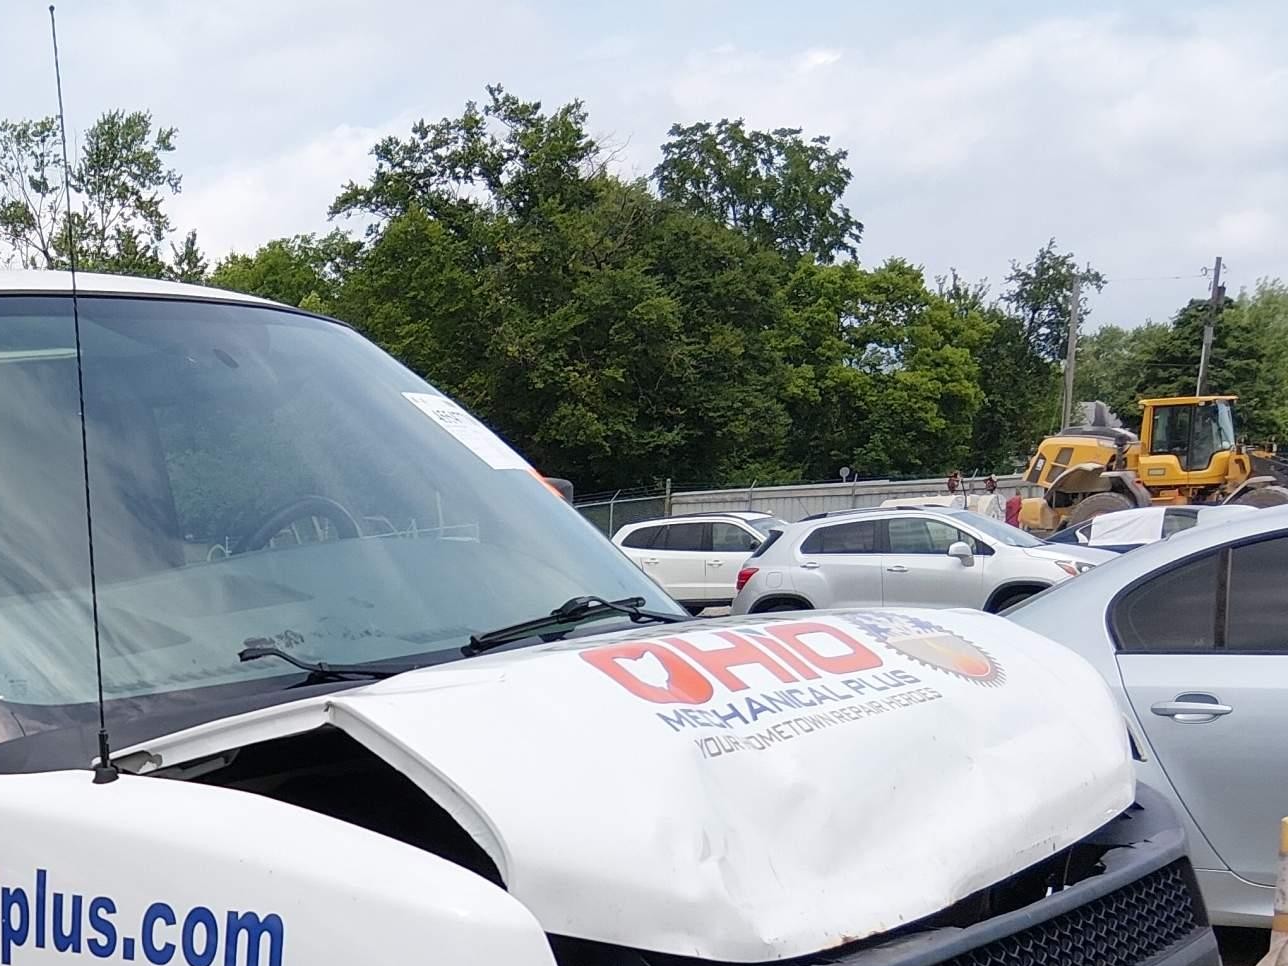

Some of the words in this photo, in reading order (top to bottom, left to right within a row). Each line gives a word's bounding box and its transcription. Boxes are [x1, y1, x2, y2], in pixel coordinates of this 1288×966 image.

[656, 684, 854, 732] MECHANICAL
[840, 669, 922, 695] PLUS
[694, 735, 743, 759] YOUR
[741, 709, 839, 751] OMETOWN
[828, 700, 884, 724] REPAIR
[880, 687, 944, 712] HEROES
